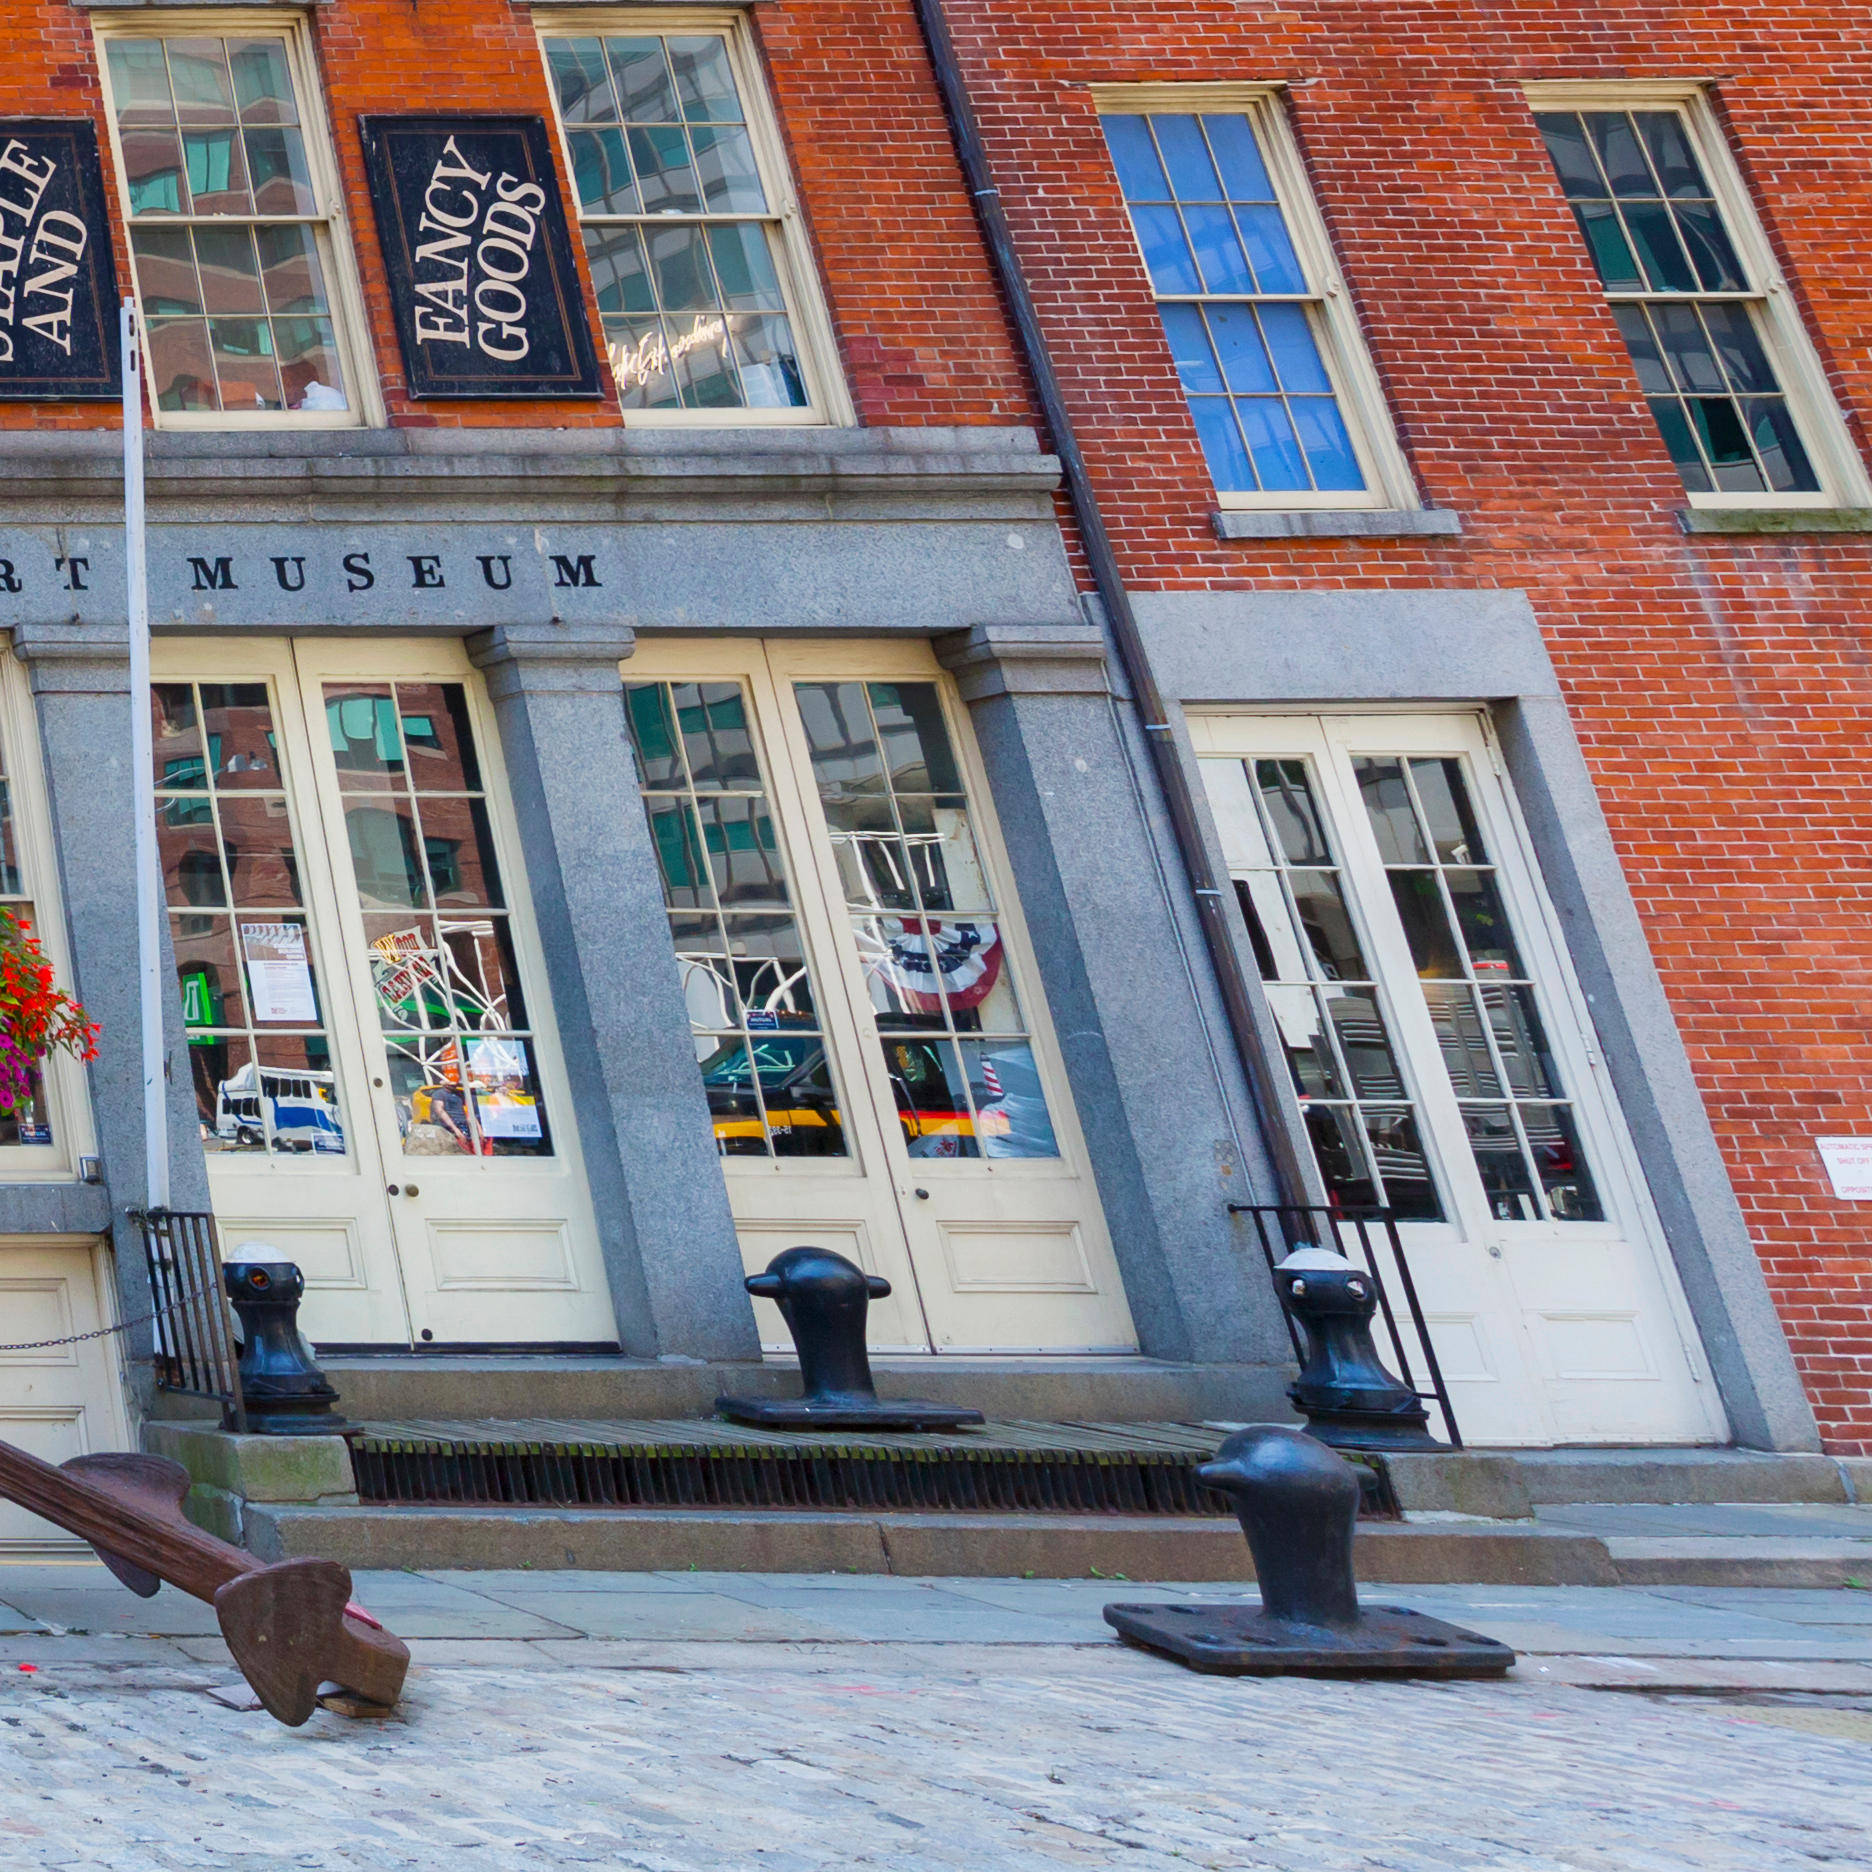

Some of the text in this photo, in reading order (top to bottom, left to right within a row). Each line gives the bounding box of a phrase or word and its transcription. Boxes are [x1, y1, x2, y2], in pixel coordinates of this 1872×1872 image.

[21, 208, 89, 356] AND
[415, 134, 492, 348] FANCY
[473, 172, 547, 362] GOODS
[191, 553, 602, 595] MUSEUM
